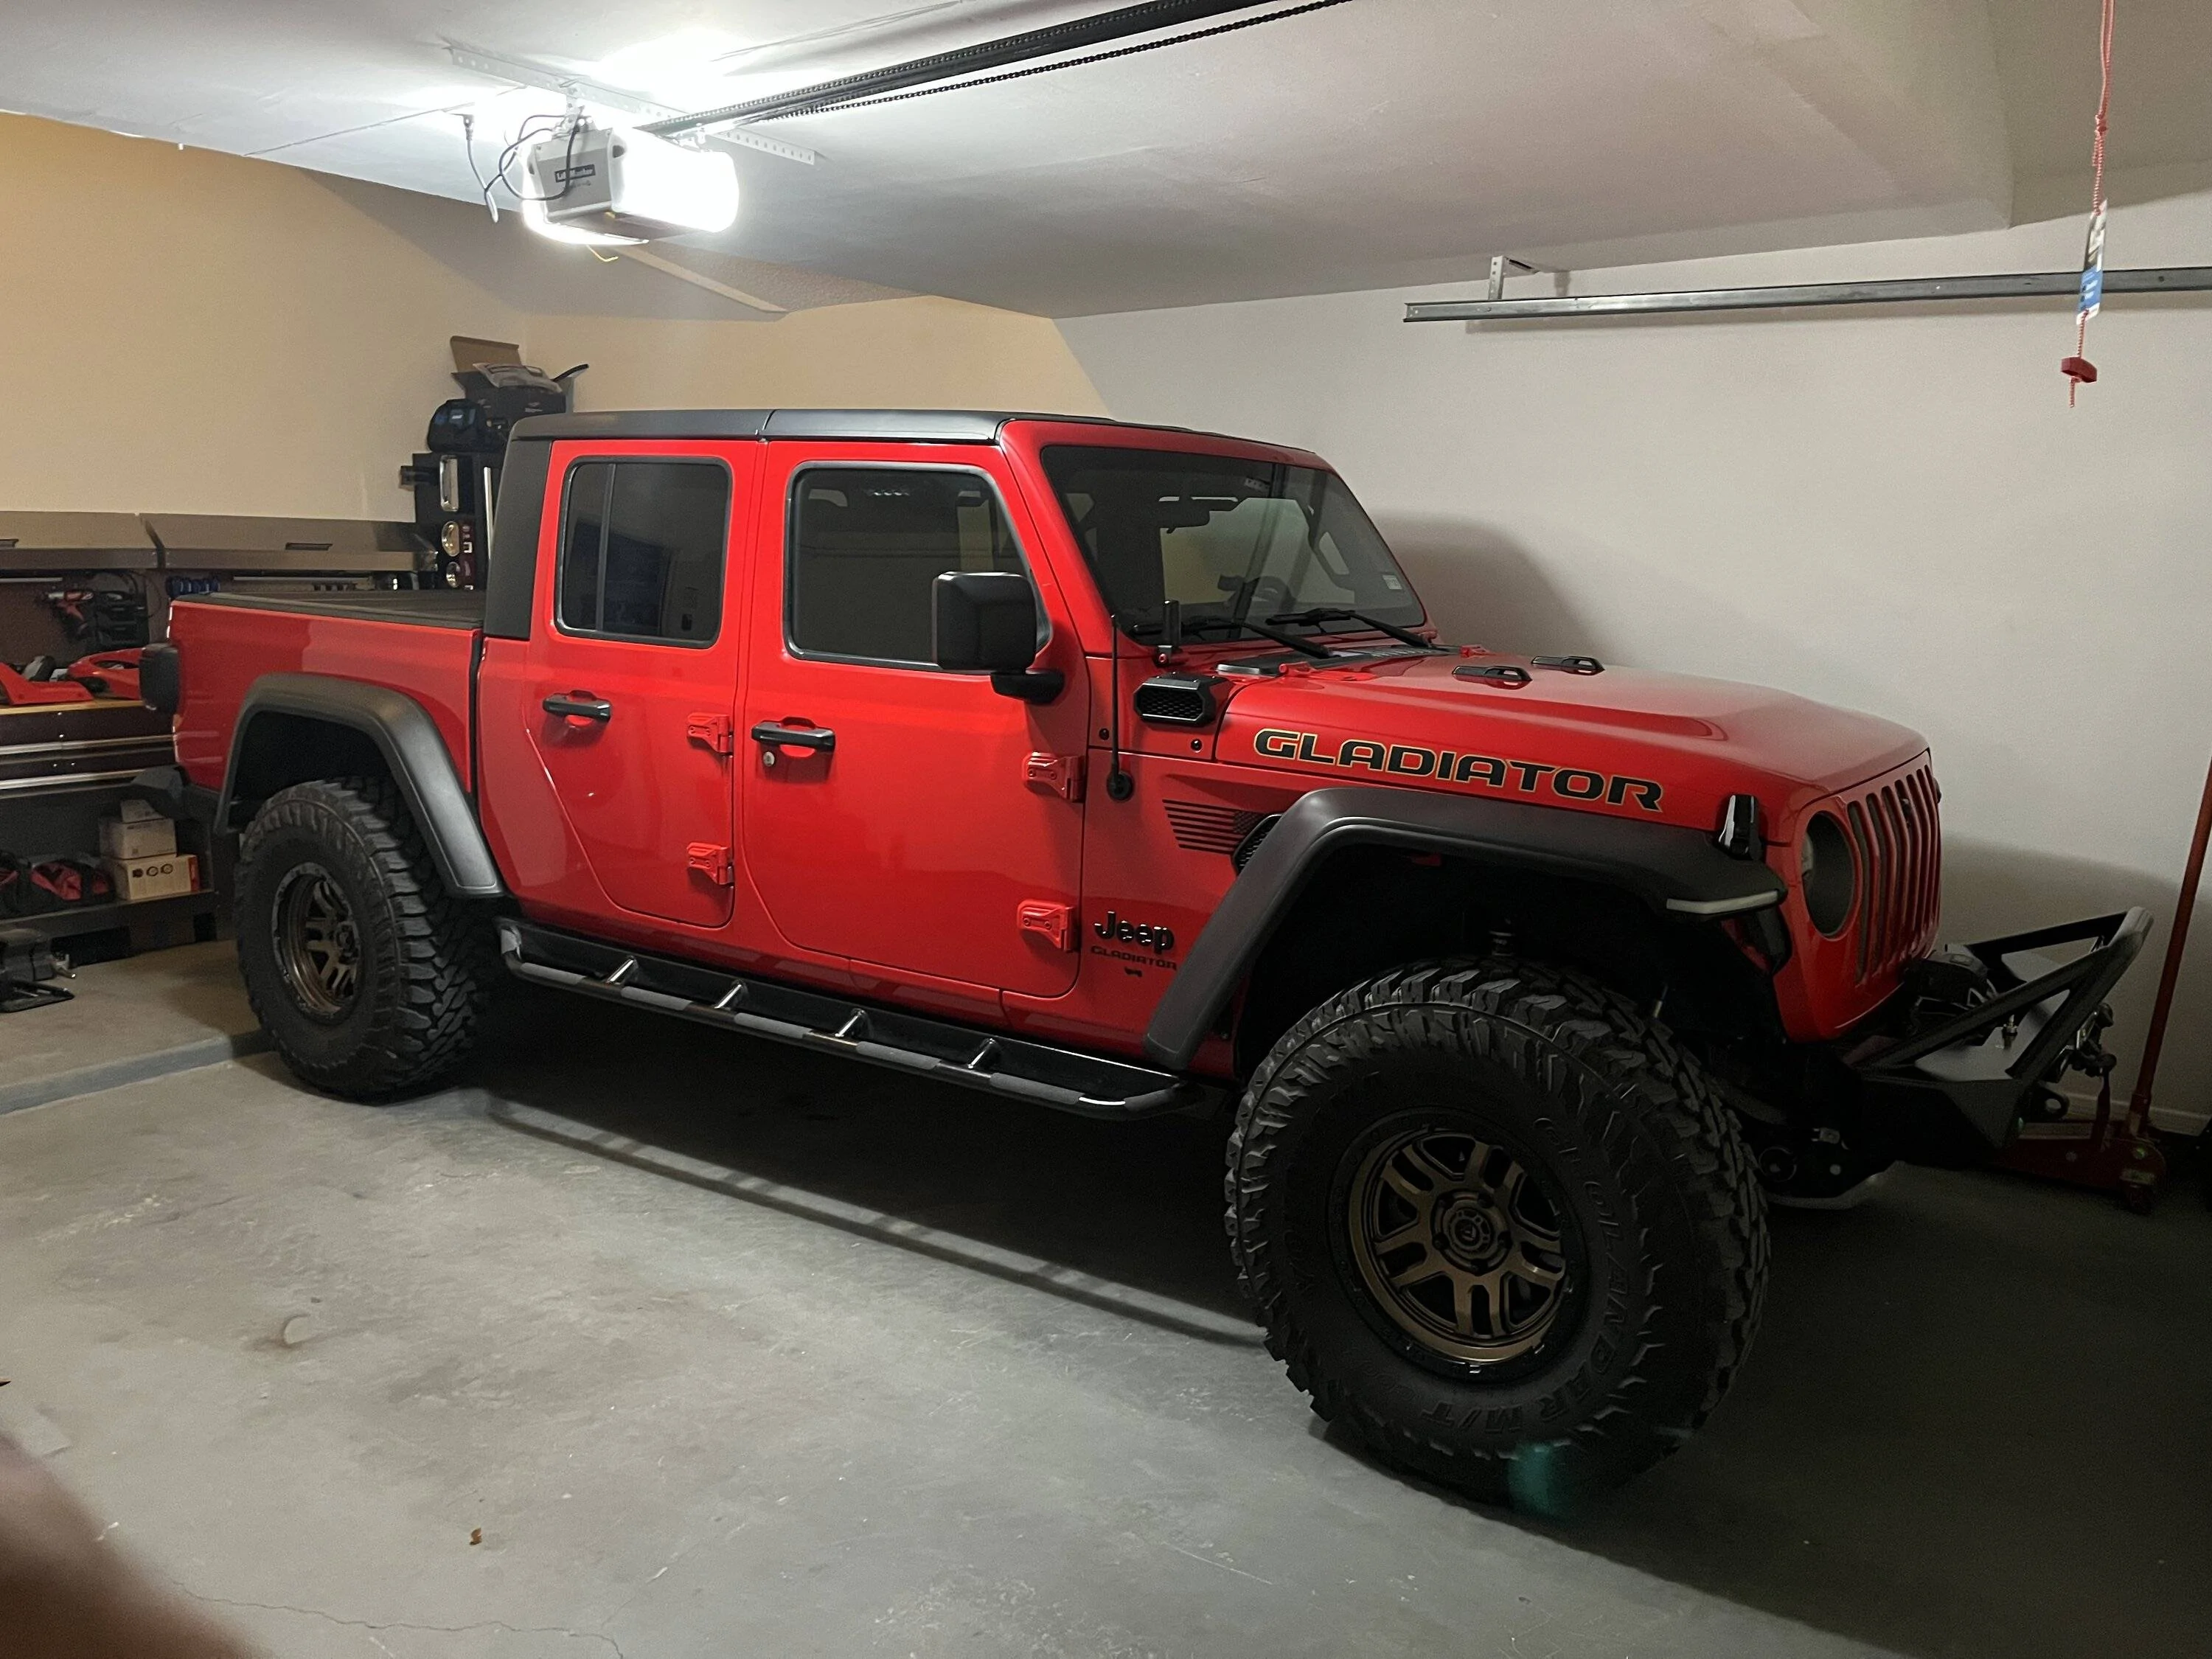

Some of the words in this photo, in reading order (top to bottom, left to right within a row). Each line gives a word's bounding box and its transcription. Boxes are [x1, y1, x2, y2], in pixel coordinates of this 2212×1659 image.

[1253, 728, 1663, 813] GLADIATOR
[1093, 911, 1175, 956] Jeep
[1091, 946, 1178, 970] GLADIATOR
